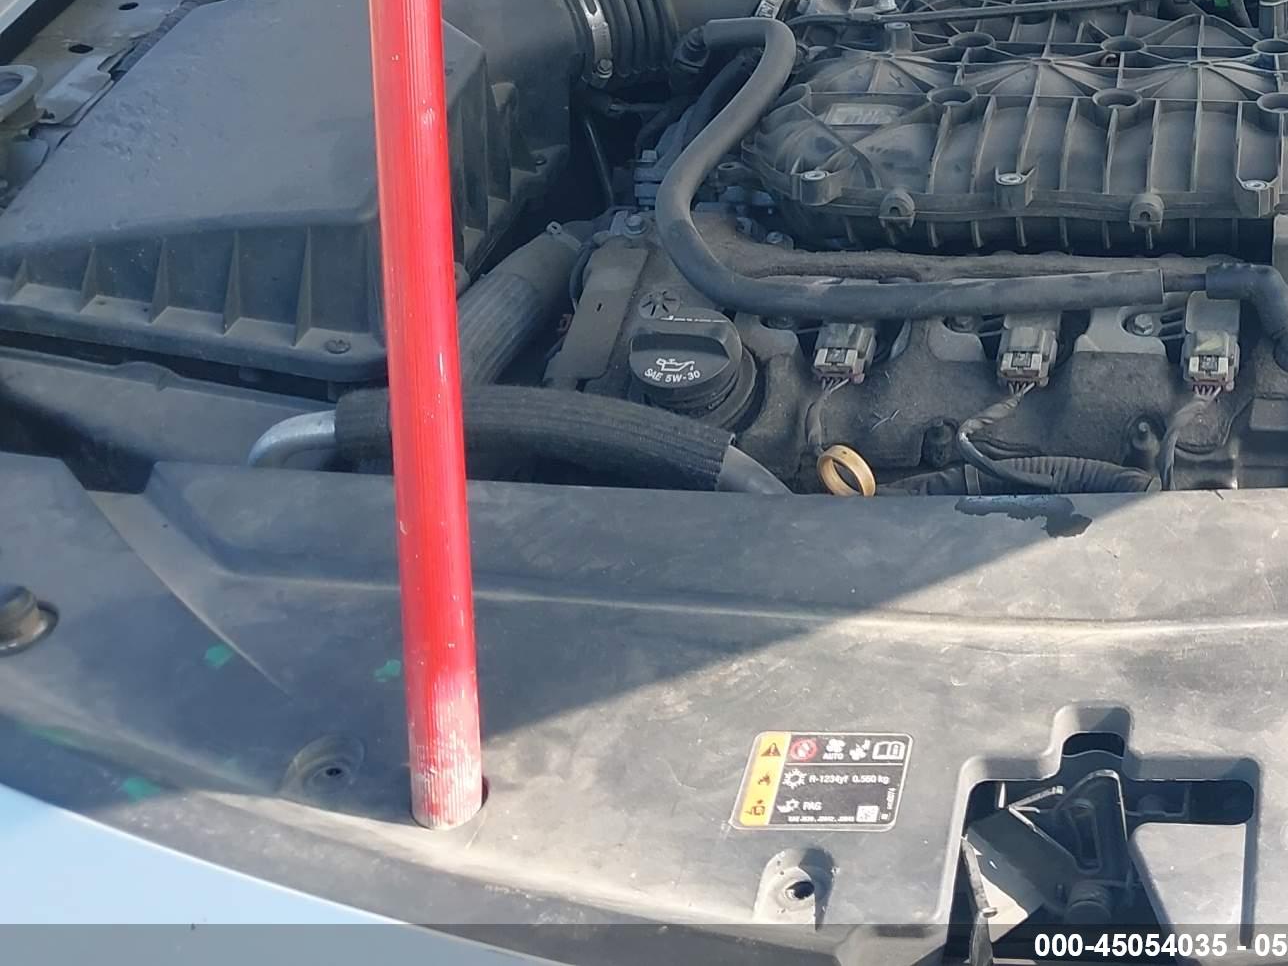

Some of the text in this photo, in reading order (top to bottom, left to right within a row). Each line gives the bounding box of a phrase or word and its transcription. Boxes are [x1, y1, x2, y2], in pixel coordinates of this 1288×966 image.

[644, 368, 700, 382] SAE 5W-30
[808, 775, 848, 785] R-1234yf
[878, 775, 890, 785] kg
[803, 801, 822, 811] PAG
